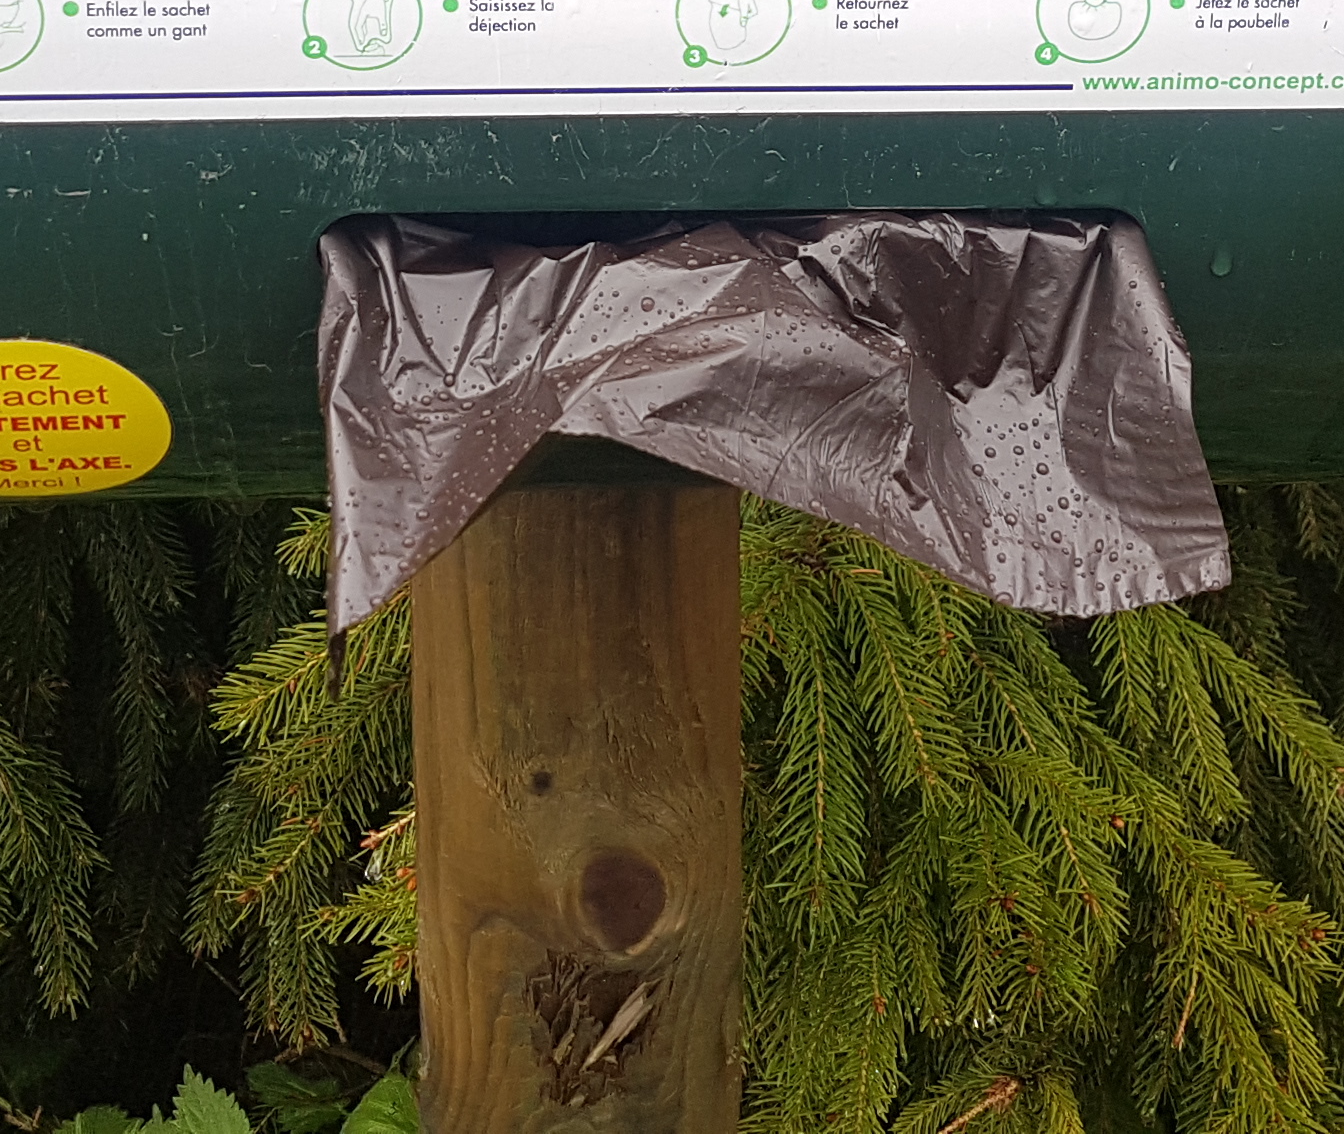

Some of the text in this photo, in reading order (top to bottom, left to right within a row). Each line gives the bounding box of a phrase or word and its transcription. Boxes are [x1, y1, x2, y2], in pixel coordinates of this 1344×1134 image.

[86, 0, 211, 17] Enfilez le sachet
[468, 16, 537, 36] déjection
[835, 14, 900, 30] le sachet
[1195, 14, 1290, 33] à la poubelle
[86, 24, 208, 41] comme un gant
[12, 434, 44, 453] et
[29, 456, 132, 472] L'AXE.
